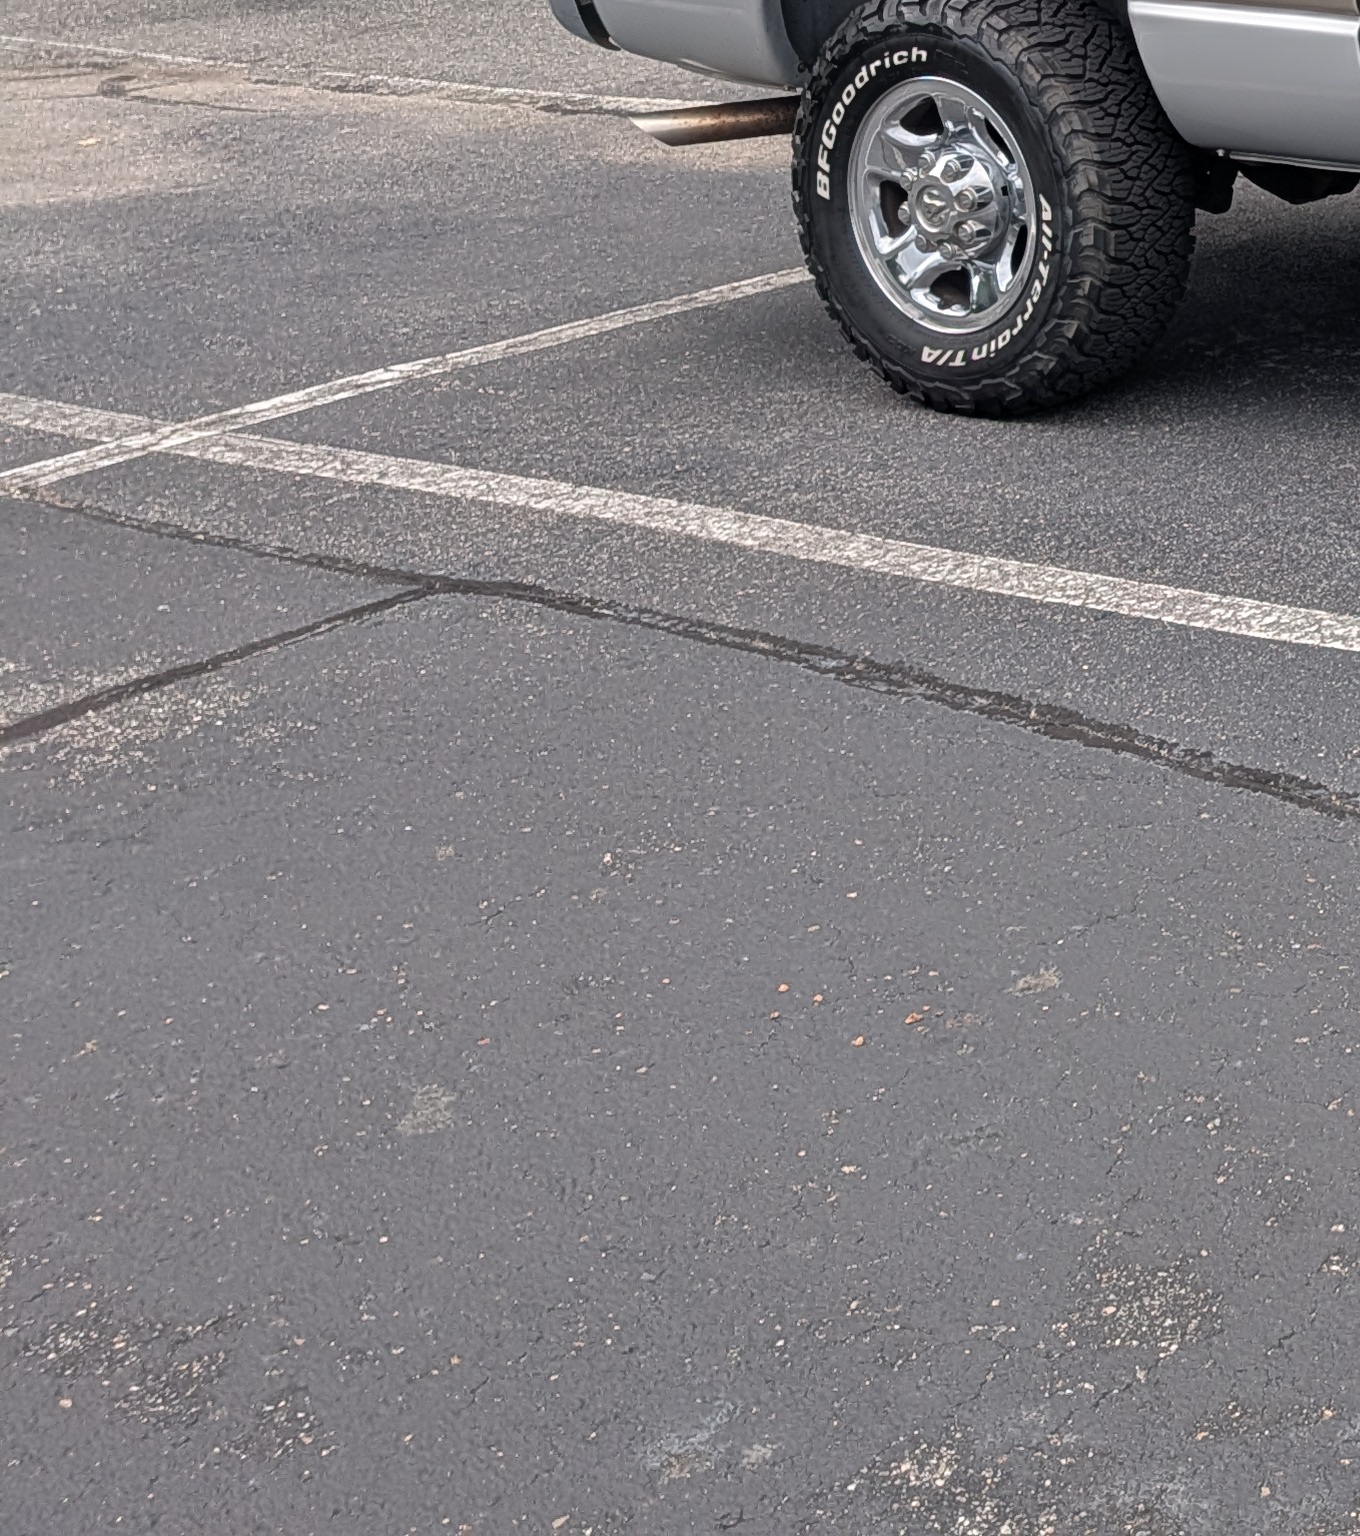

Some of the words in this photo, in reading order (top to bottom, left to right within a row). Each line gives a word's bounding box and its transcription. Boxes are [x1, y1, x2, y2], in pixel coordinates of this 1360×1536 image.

[816, 46, 928, 201] BFGoodrich
[919, 343, 969, 368] T/A
[970, 192, 1054, 364] All-Terrain
